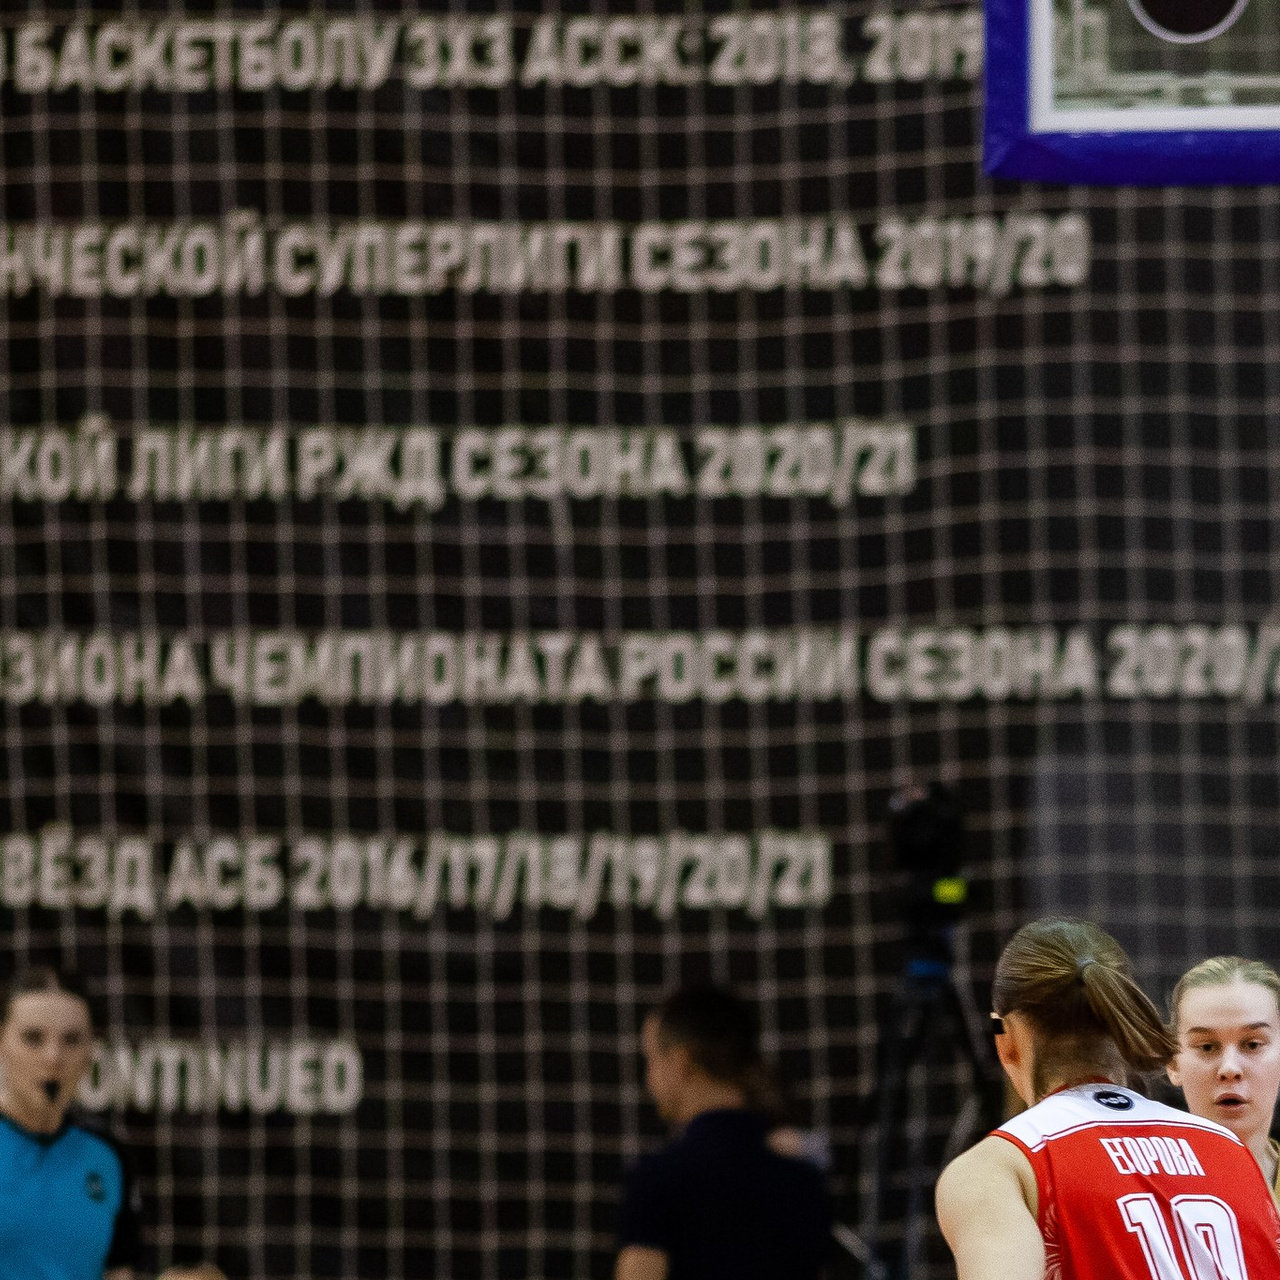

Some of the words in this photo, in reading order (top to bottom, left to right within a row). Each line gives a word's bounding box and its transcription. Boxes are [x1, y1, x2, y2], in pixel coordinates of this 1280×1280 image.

[14, 19, 398, 92] БАСКЕТБОЛУ
[273, 221, 628, 298] СУПЕРЛИГИ
[631, 216, 869, 294] СЕЗОНА
[872, 210, 1090, 298] 2019/20
[0, 410, 118, 501] КОЙ
[128, 426, 291, 501] ЛИГИ
[298, 426, 445, 513] РЖД
[450, 424, 690, 500] СЕЗОНА
[698, 419, 916, 507] 2020/21
[208, 630, 612, 704] ЧЕМПИОНАТА
[619, 628, 861, 703] РОССИИ
[865, 625, 1099, 702] СЕЗОНА
[164, 832, 285, 911] АСБ
[291, 828, 834, 921] 2016/17/18/19/20/21
[1099, 1136, 1207, 1177] ЕГОРОВА
